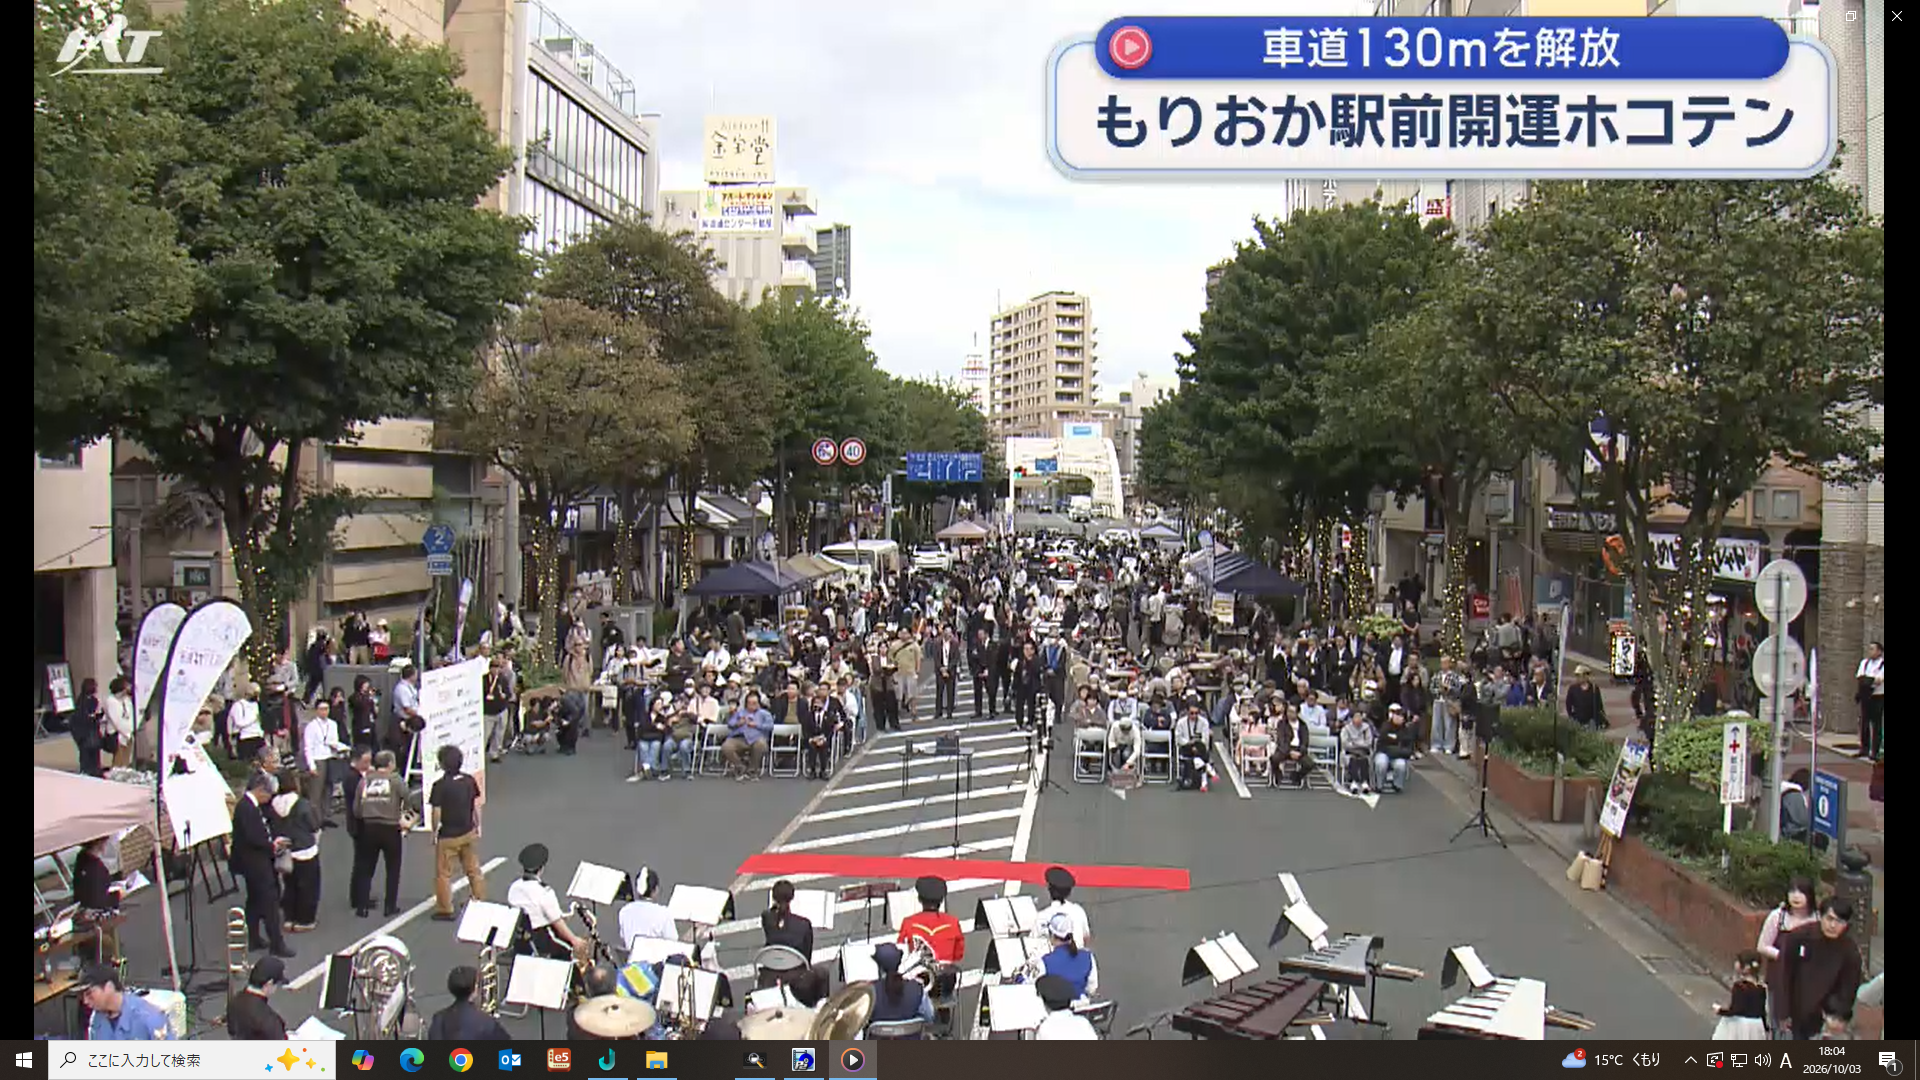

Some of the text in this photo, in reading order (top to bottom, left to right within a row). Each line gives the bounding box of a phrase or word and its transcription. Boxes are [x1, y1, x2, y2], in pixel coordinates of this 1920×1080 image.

[846, 445, 860, 457] 40
[434, 531, 445, 545] 2
[554, 1052, 569, 1062] e5
[1818, 1046, 1846, 1056] 18:04
[88, 1053, 201, 1068] ここに入力して検索
[1632, 1052, 1660, 1067] くもり
[1779, 1052, 1793, 1069] A
[1802, 1063, 1862, 1075] 2026/10/03
